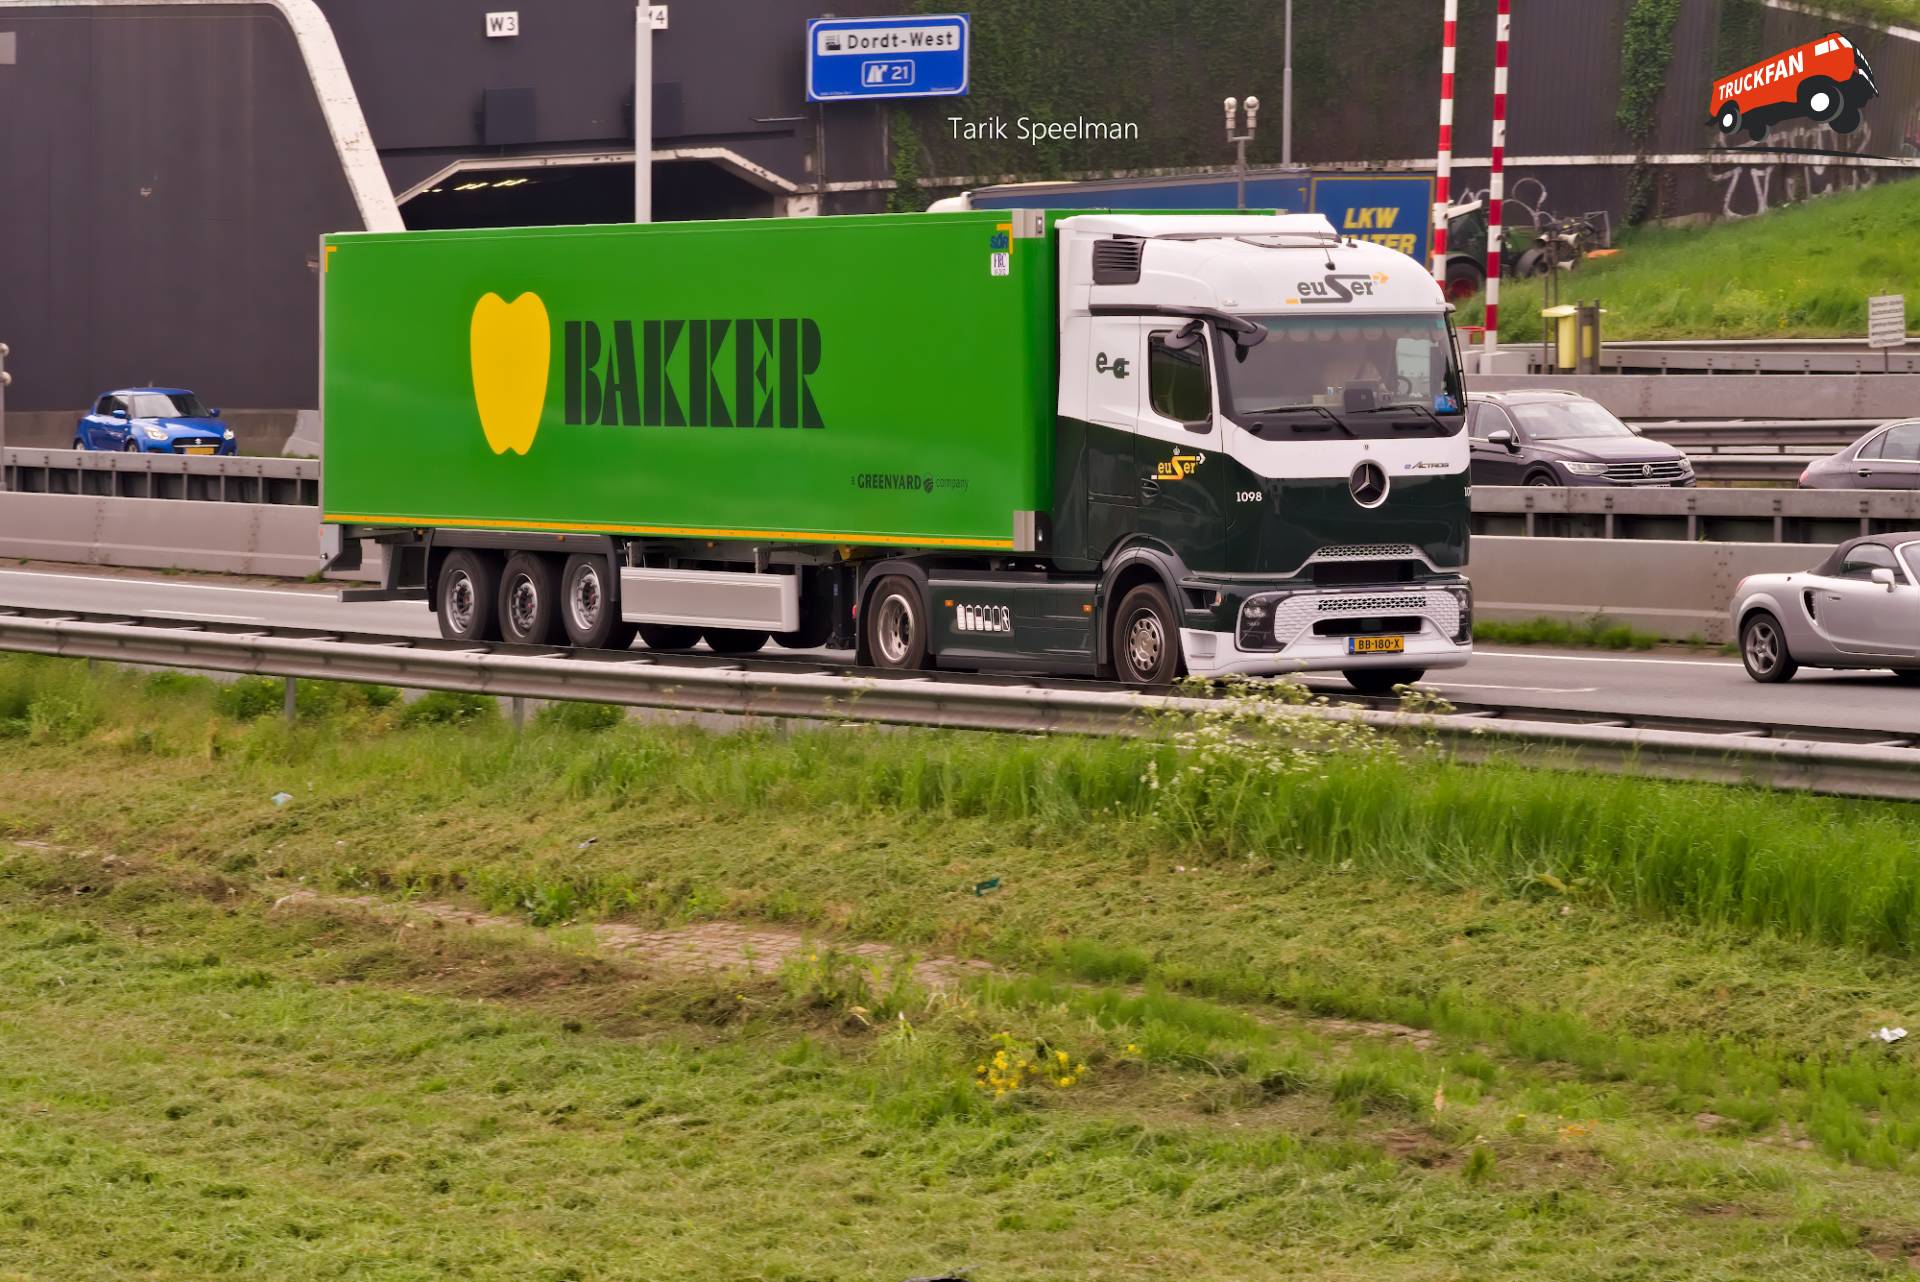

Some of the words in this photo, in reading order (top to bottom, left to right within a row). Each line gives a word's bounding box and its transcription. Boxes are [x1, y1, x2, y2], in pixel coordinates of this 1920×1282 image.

[847, 32, 953, 49] Dordt-West
[891, 66, 909, 80] 21
[1343, 207, 1399, 229] LKW
[564, 318, 826, 429] BAKKER
[857, 473, 921, 490] GREENYARD
[1235, 491, 1262, 502] 1098
[1358, 638, 1400, 650] BB-180-X
